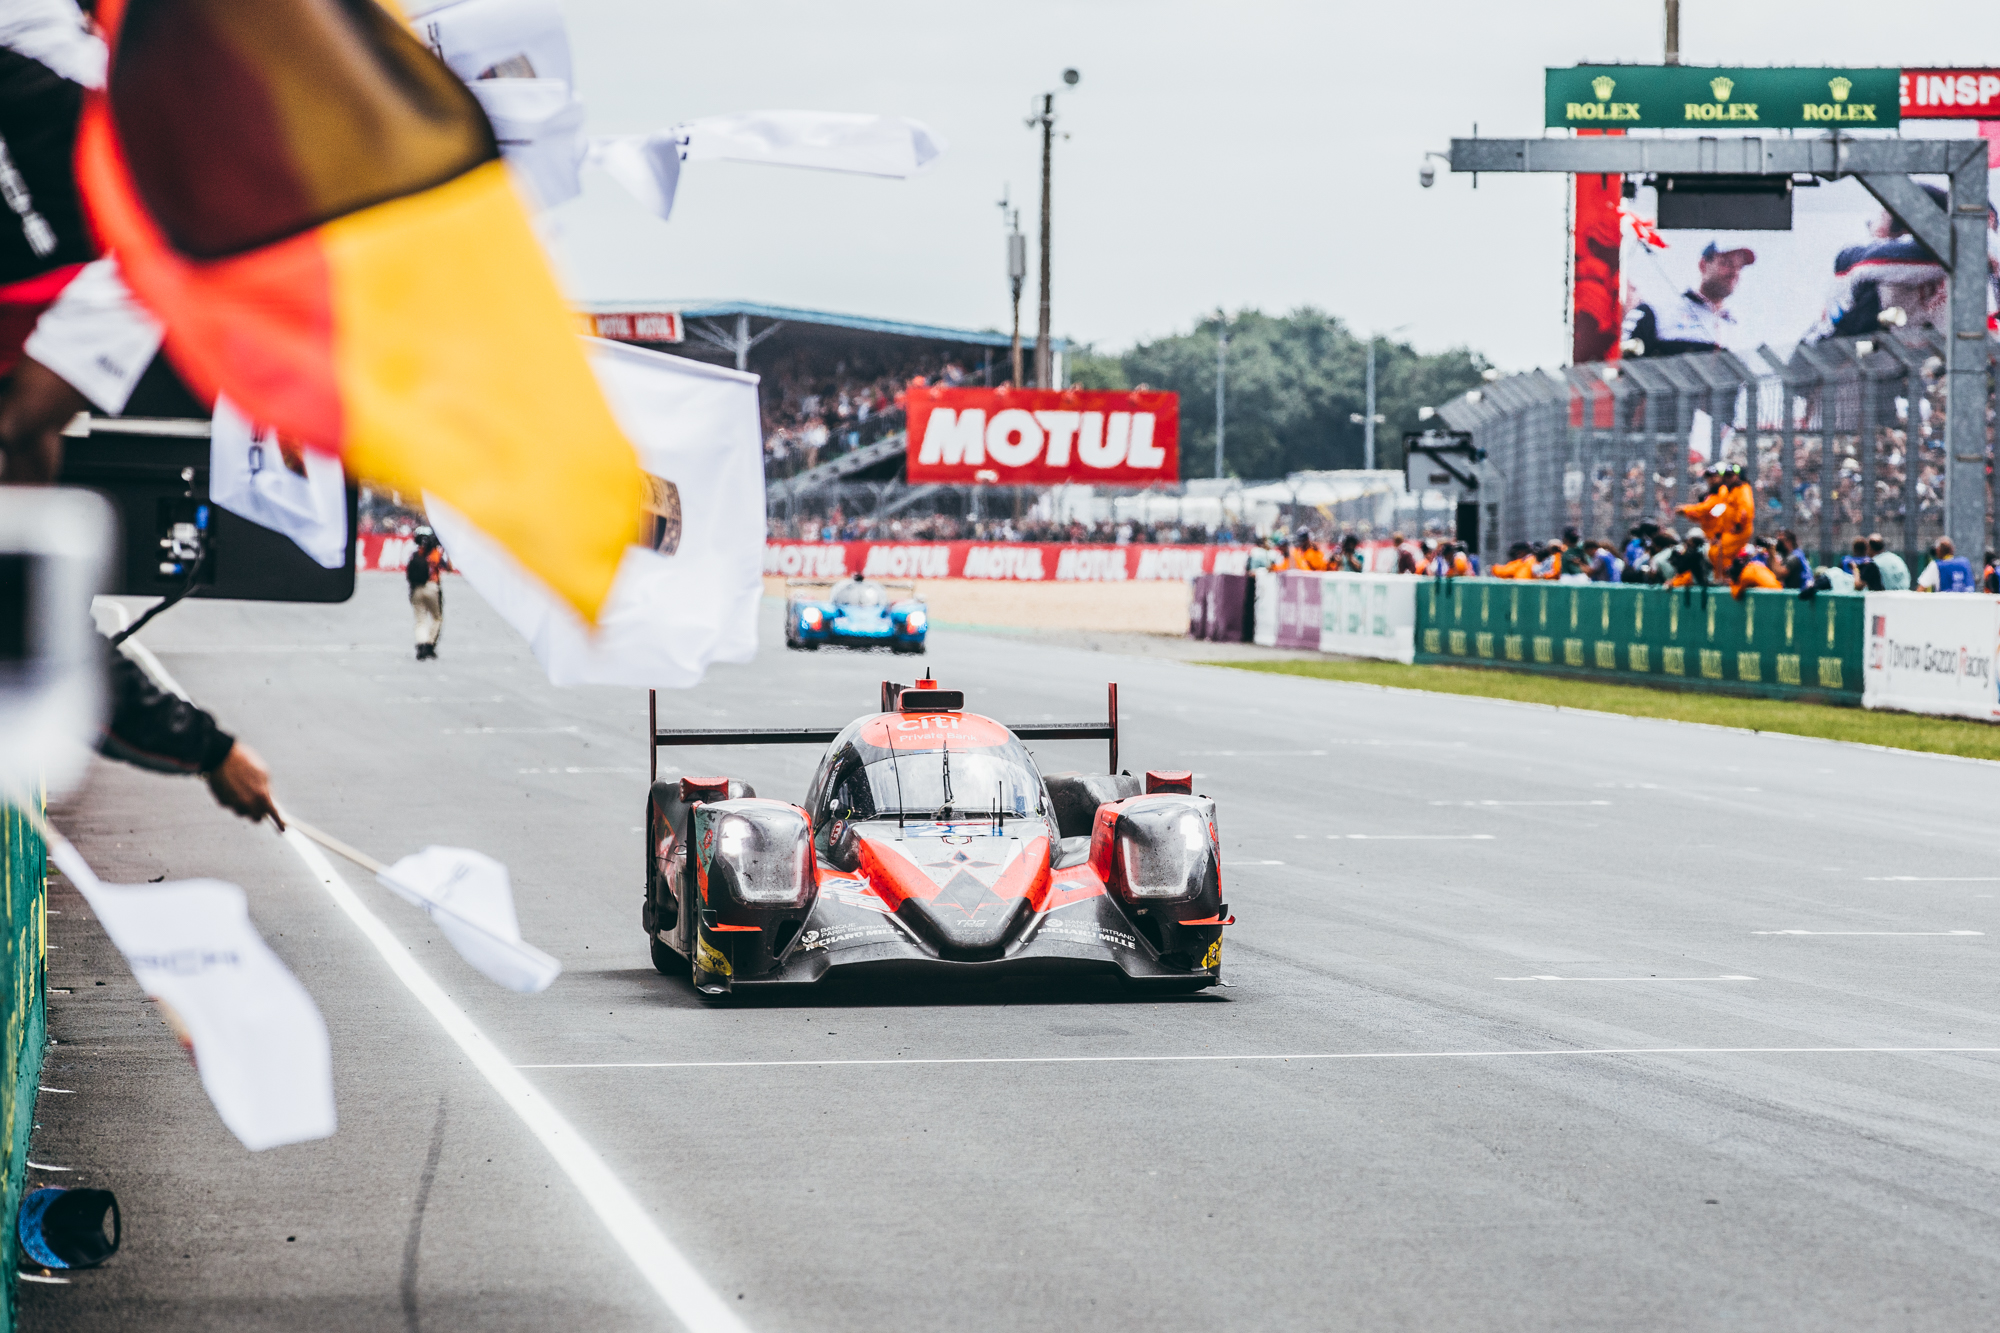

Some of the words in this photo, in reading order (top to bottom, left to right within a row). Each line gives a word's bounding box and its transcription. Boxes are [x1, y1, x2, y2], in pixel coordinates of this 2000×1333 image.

[1916, 75, 2000, 106] INSP
[1566, 103, 1641, 121] ROLEX
[1684, 103, 1760, 121] ROLEX
[1803, 103, 1877, 121] ROLEX
[918, 407, 1166, 469] MOTUL
[765, 544, 847, 578] MOTUL
[862, 545, 951, 578] MOTUL
[963, 546, 1045, 580] MOTUL
[1055, 549, 1127, 580] MOTUL
[1960, 646, 1989, 689] Racing
[896, 715, 960, 731] citi
[900, 733, 942, 742] Private
[946, 732, 978, 742] Bank
[913, 825, 992, 838] 28
[820, 922, 856, 933] BANQUE
[1065, 919, 1100, 928] BANQUE
[821, 928, 847, 938] PARIS
[1038, 926, 1097, 939] RICHARD
[1098, 933, 1136, 950] MILLE
[1065, 924, 1091, 932] PARIS
[1092, 926, 1136, 942] BERTRAND
